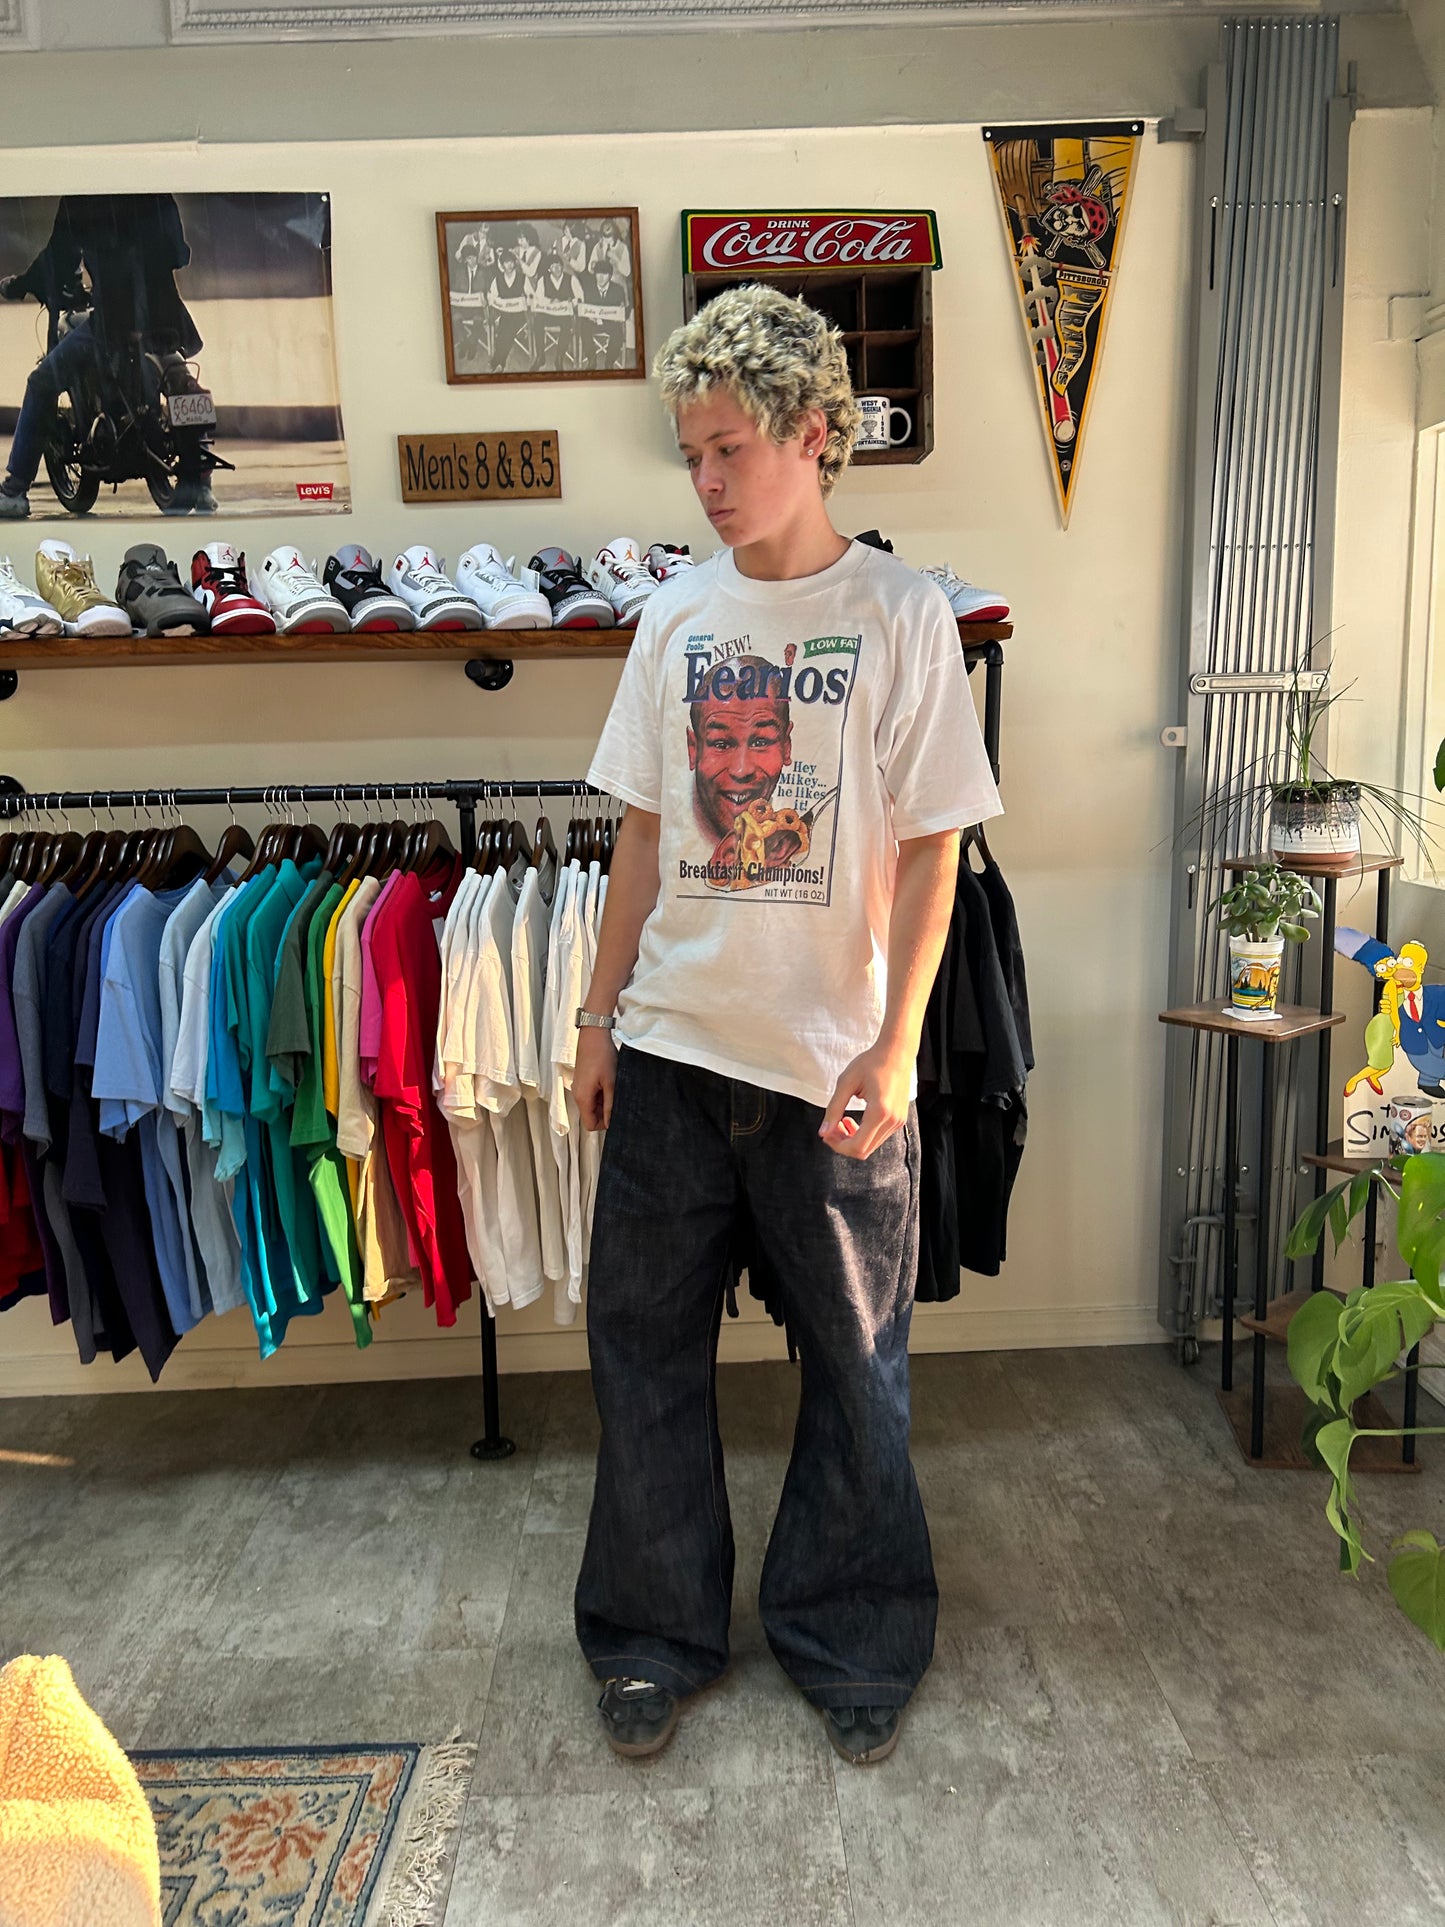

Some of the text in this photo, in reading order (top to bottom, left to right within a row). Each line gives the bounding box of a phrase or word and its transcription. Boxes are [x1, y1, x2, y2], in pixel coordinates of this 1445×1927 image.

[767, 220, 810, 229] DRINK
[702, 219, 917, 268] Coca-Cola
[1058, 270, 1107, 286] PITTSBURGH
[406, 440, 554, 491] Men's 8 & 8.5
[687, 633, 714, 642] General
[810, 638, 857, 651] LOW FAT
[713, 634, 752, 662] NEW!
[793, 761, 817, 775] Hey
[779, 773, 827, 788] Mikey...
[777, 785, 826, 800] he likes
[794, 801, 808, 812] it!
[780, 888, 793, 898] WT
[810, 889, 826, 902] OZ)
